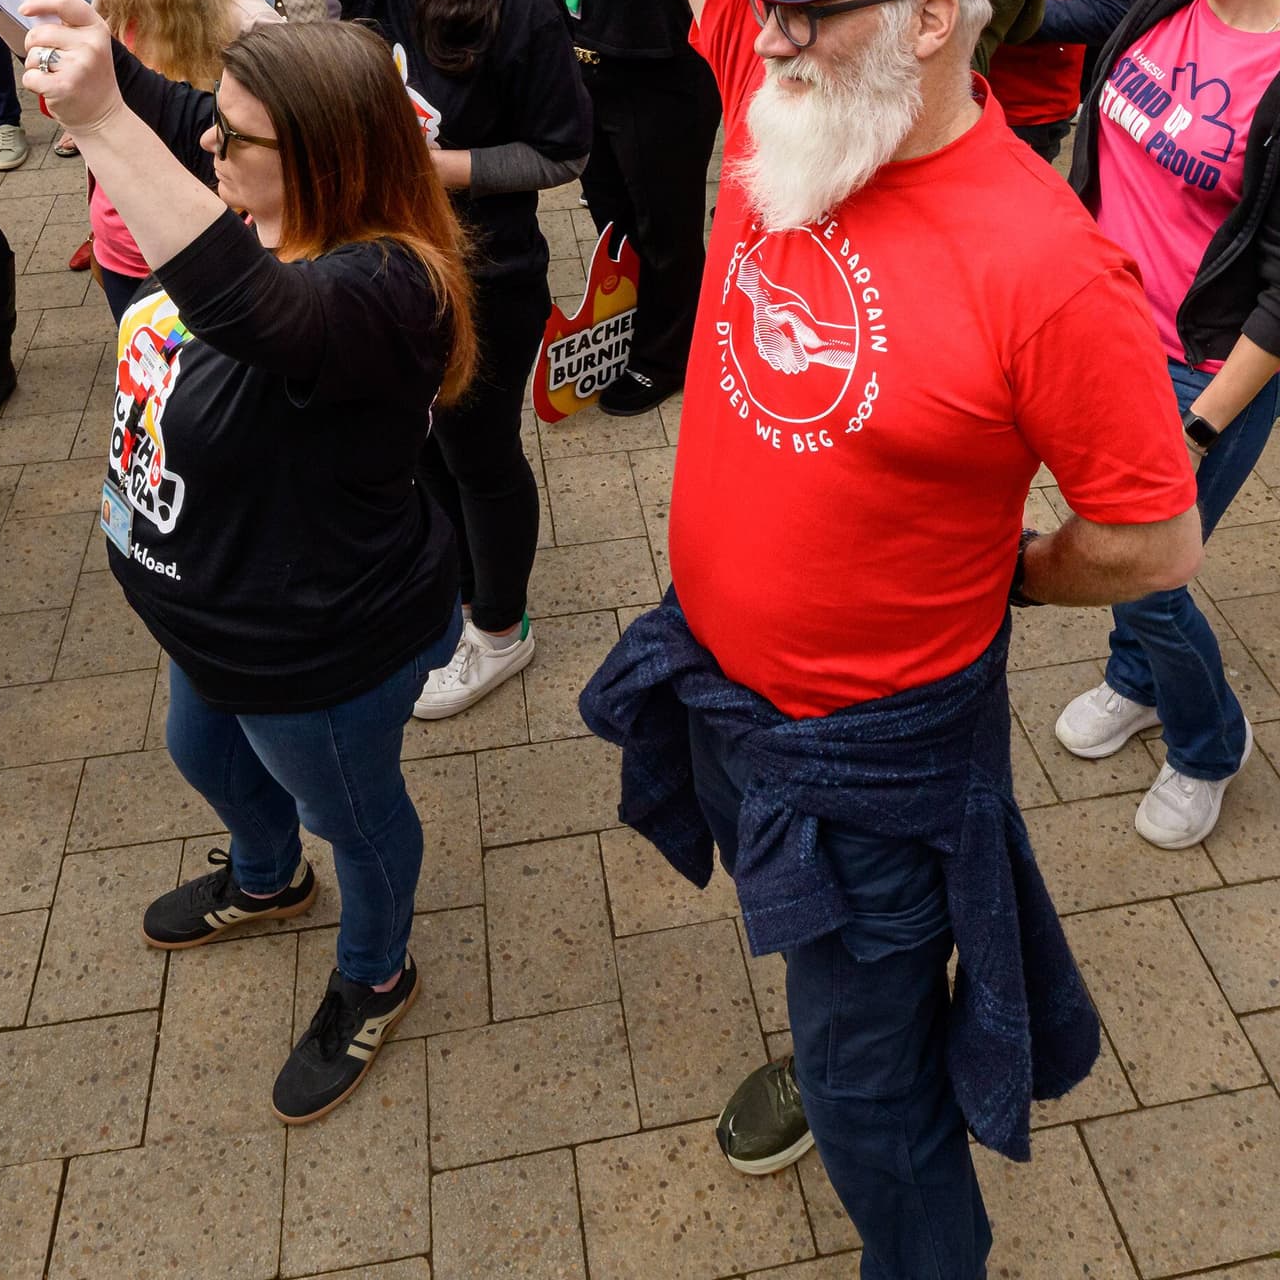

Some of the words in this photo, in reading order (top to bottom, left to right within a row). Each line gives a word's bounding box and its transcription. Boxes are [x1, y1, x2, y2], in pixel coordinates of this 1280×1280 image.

[1138, 53, 1166, 81] HACSU
[1110, 56, 1173, 120] STAND
[1163, 103, 1193, 139] UP
[1099, 80, 1151, 144] STAND
[1145, 130, 1222, 192] PROUD
[839, 237, 889, 354] BARGAIN
[551, 313, 635, 363] TEACHE
[552, 334, 634, 387] BURNIN
[579, 360, 627, 394] OUT
[755, 418, 782, 450] WE
[792, 428, 834, 454] BEG
